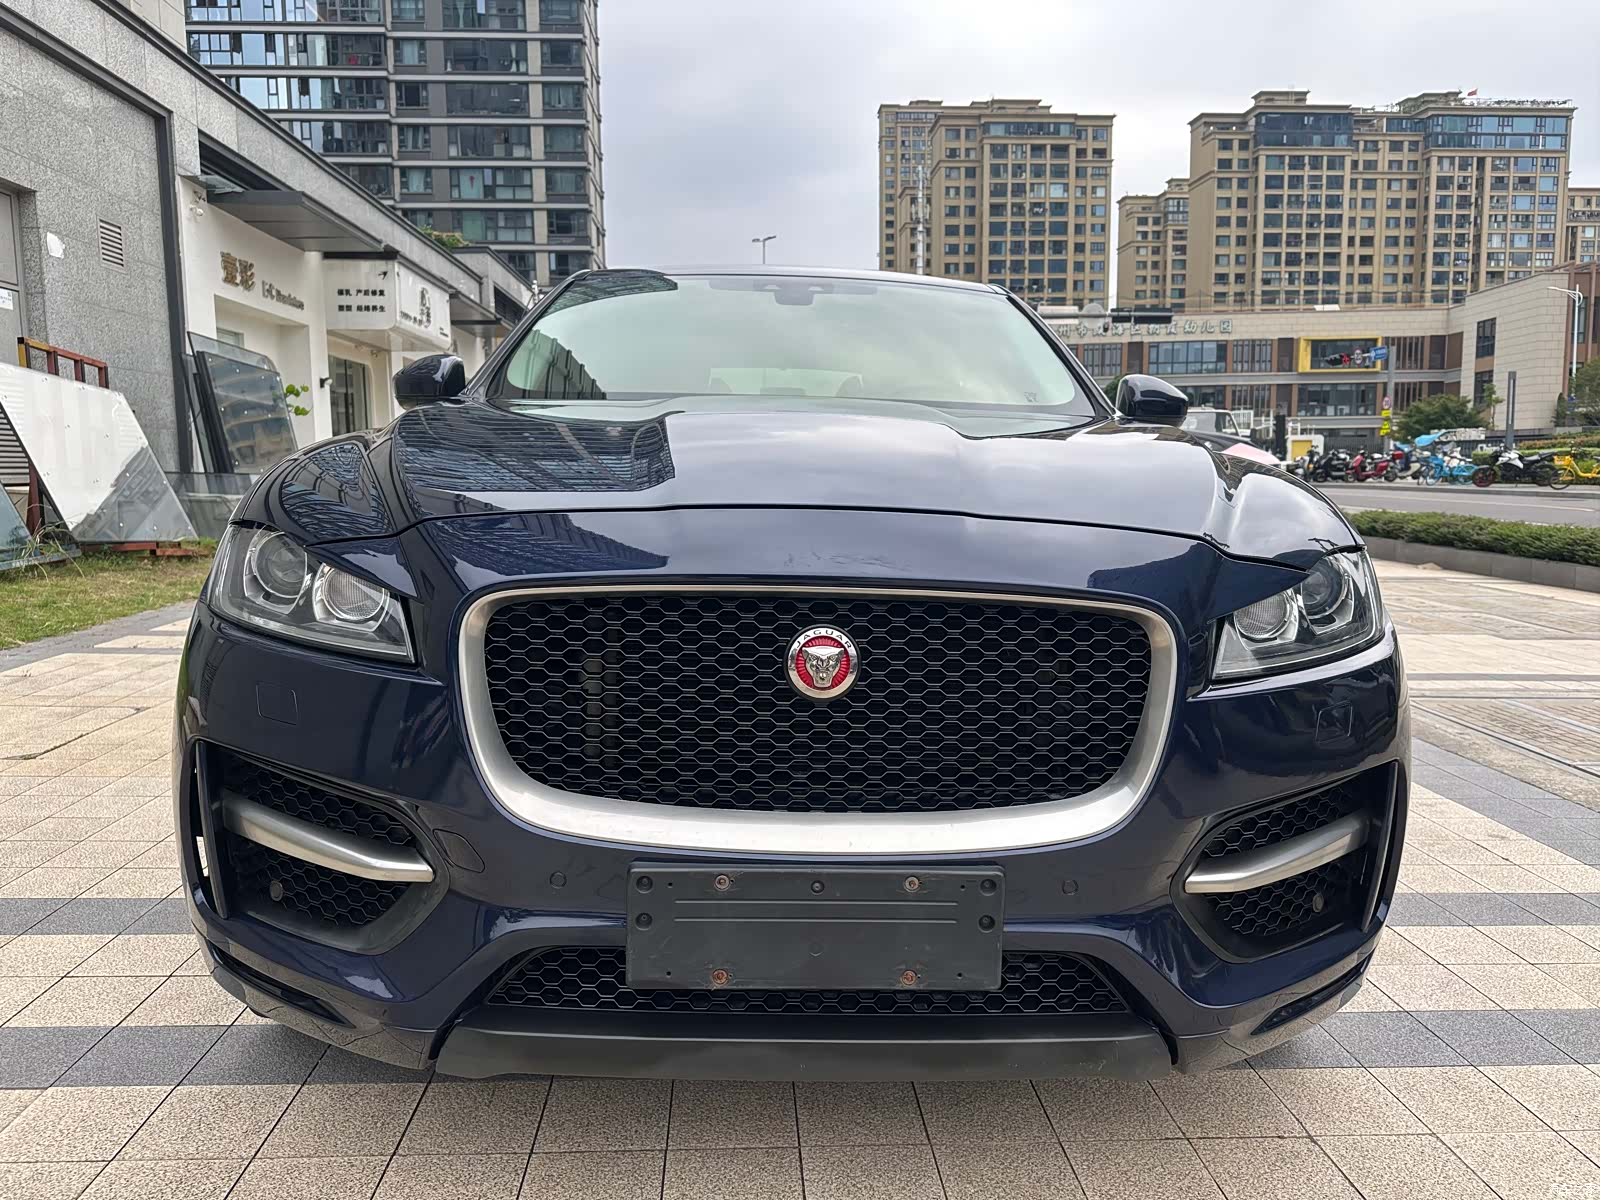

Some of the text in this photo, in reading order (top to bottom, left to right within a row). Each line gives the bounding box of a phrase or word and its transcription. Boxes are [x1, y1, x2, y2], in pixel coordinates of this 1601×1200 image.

[356, 288, 386, 297] 产后修复
[796, 629, 852, 649] JAGUAR
